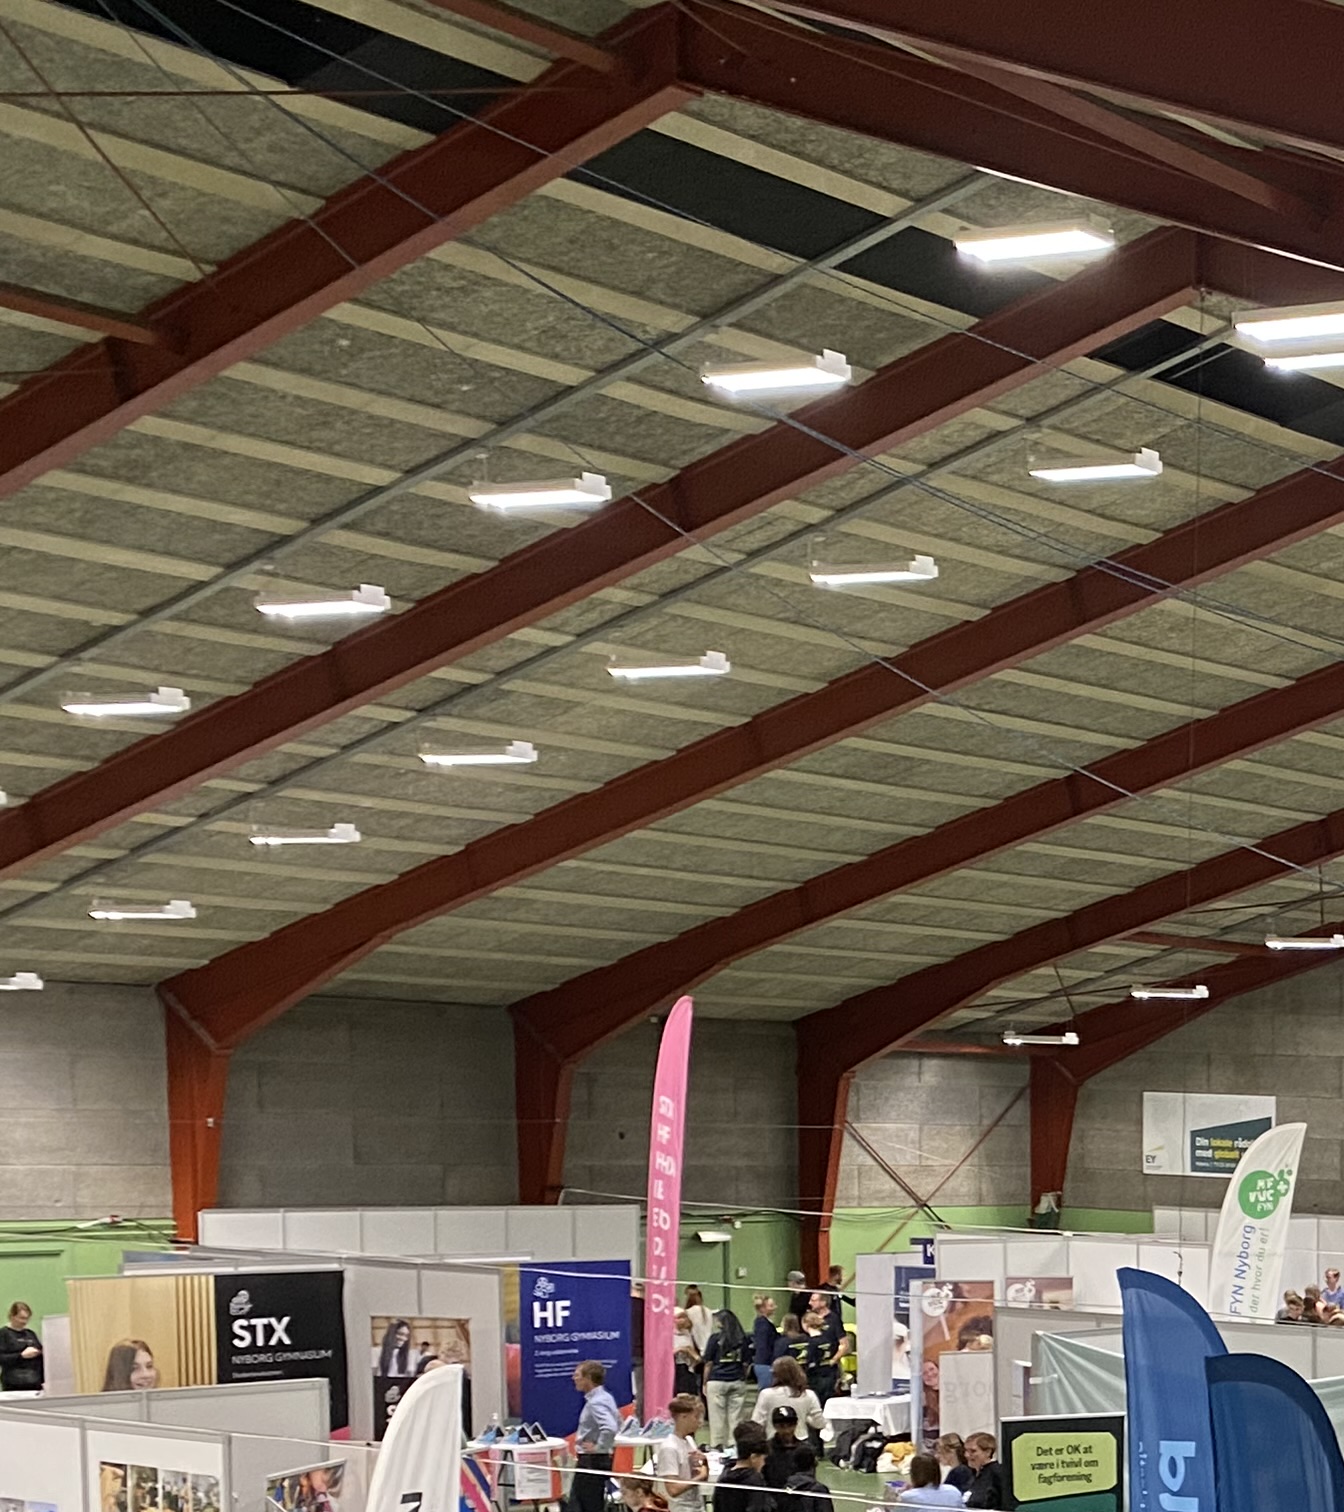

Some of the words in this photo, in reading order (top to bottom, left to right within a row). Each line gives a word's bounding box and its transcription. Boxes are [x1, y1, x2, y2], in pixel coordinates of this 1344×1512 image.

[1146, 1155, 1156, 1164] EY
[1234, 1225, 1256, 1280] Nyborg
[1230, 1286, 1244, 1316] FYN
[533, 1300, 571, 1328] HF
[232, 1316, 292, 1348] STX
[1036, 1446, 1053, 1456] Det
[1054, 1448, 1064, 1456] er
[1066, 1444, 1080, 1455] OK
[1082, 1445, 1093, 1454] at
[1084, 1460, 1099, 1468] om
[1038, 1472, 1092, 1484] fagforening
